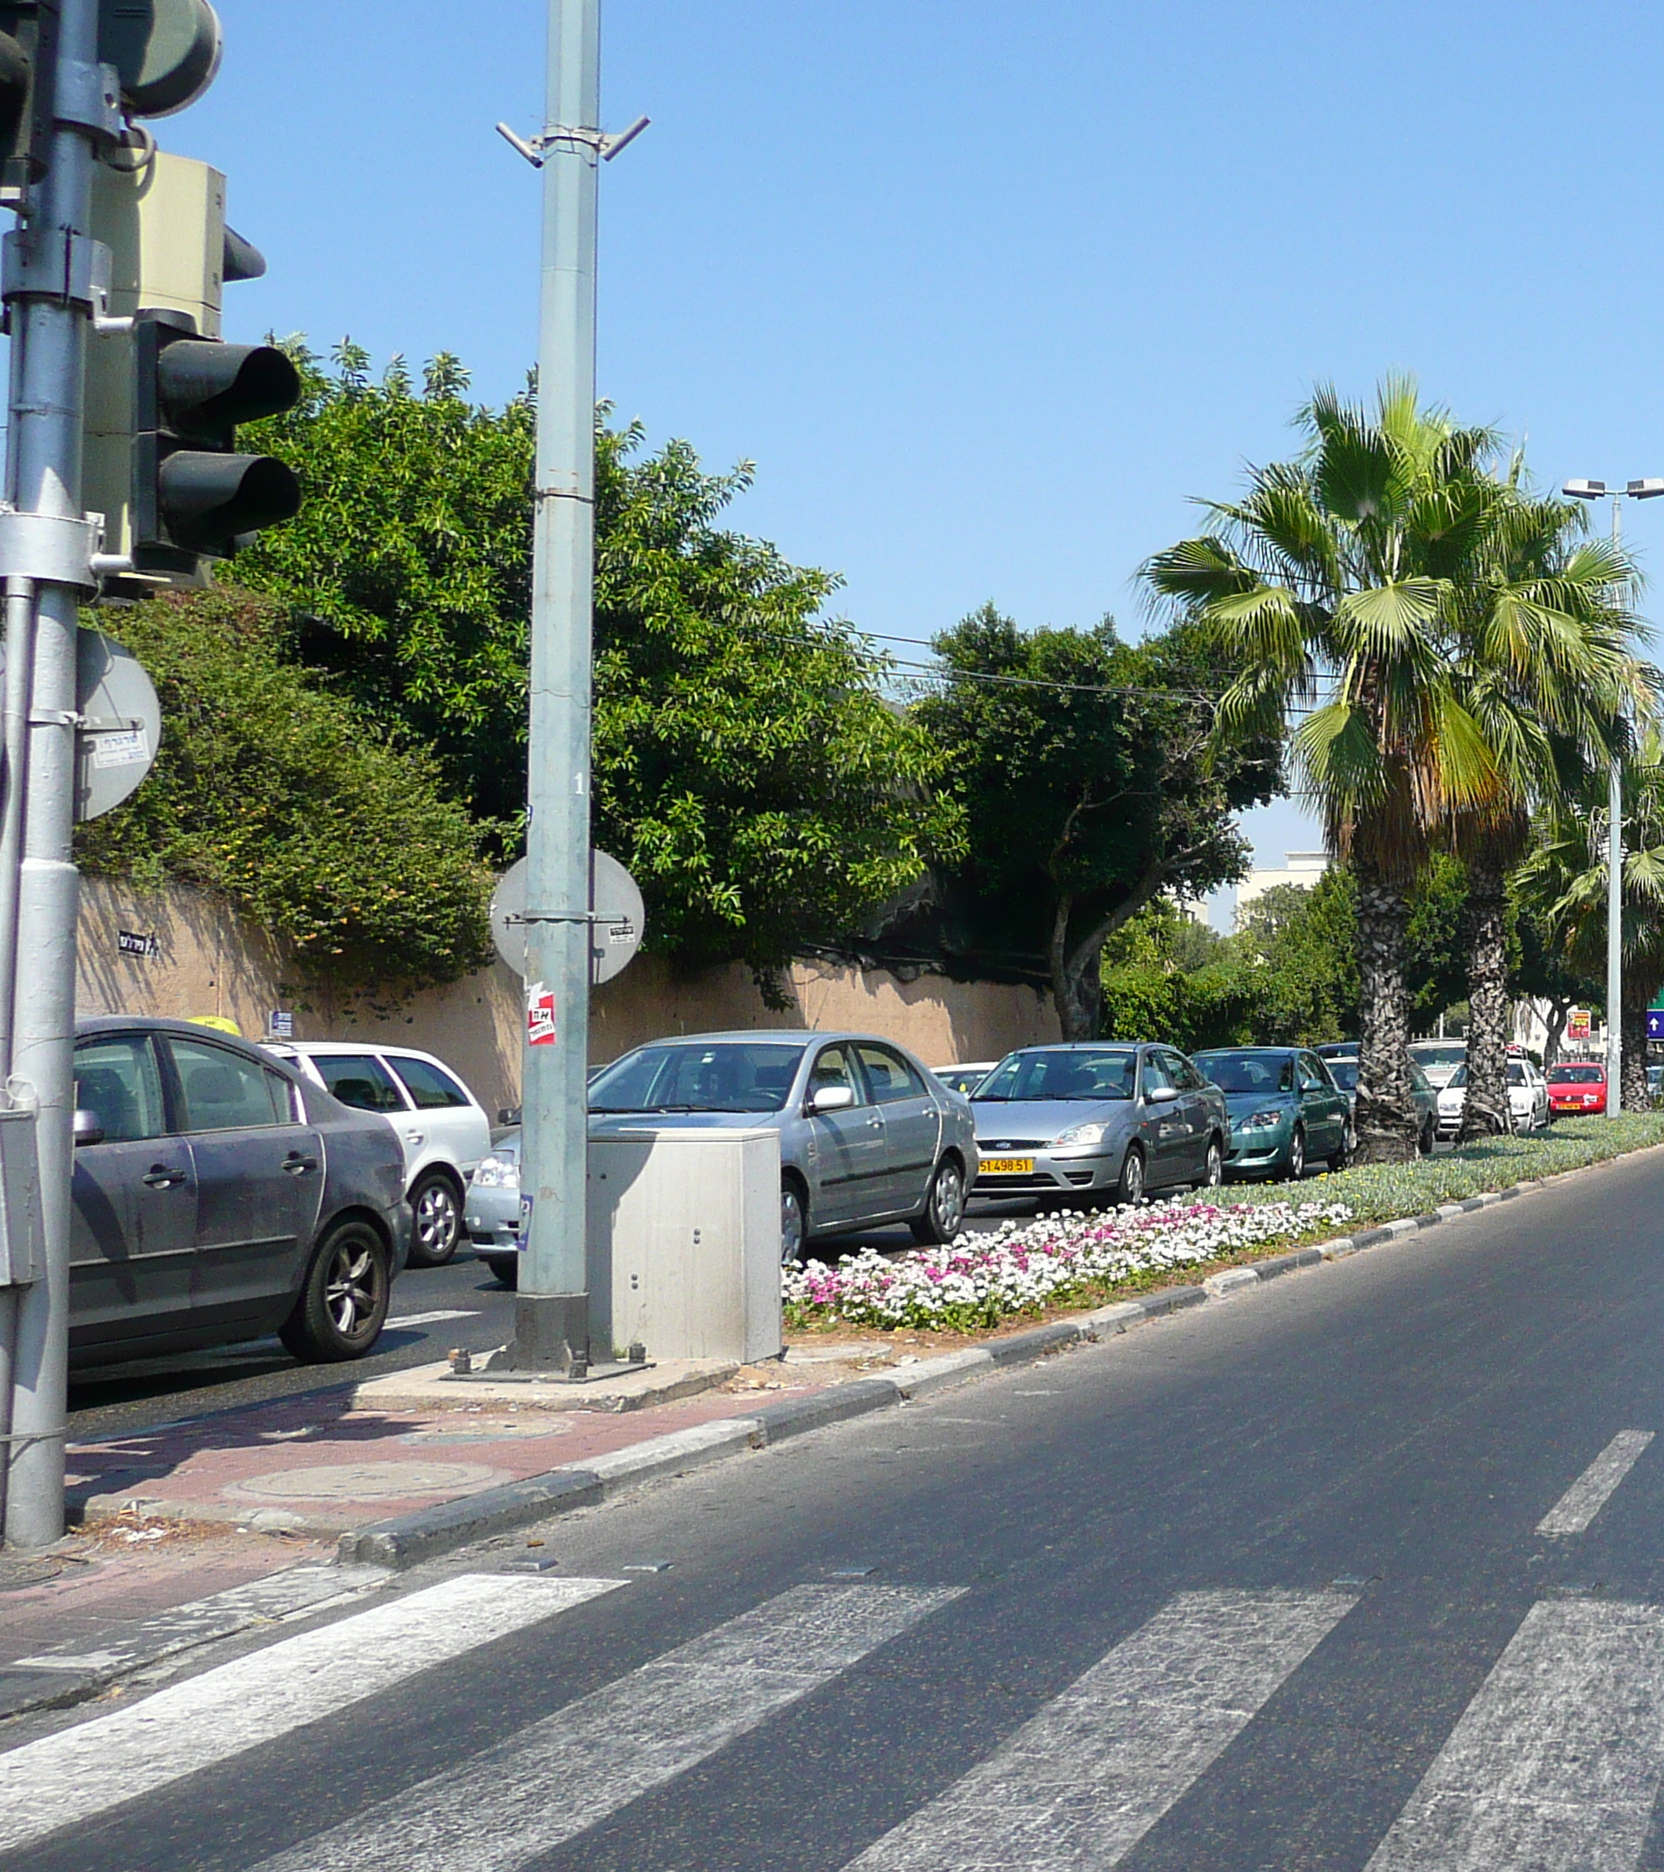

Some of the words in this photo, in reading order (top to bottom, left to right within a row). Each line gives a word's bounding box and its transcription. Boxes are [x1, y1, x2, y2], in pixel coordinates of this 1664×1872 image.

[980, 1160, 991, 1172] 51
[994, 1160, 1014, 1172] 498
[1016, 1160, 1028, 1171] 51
